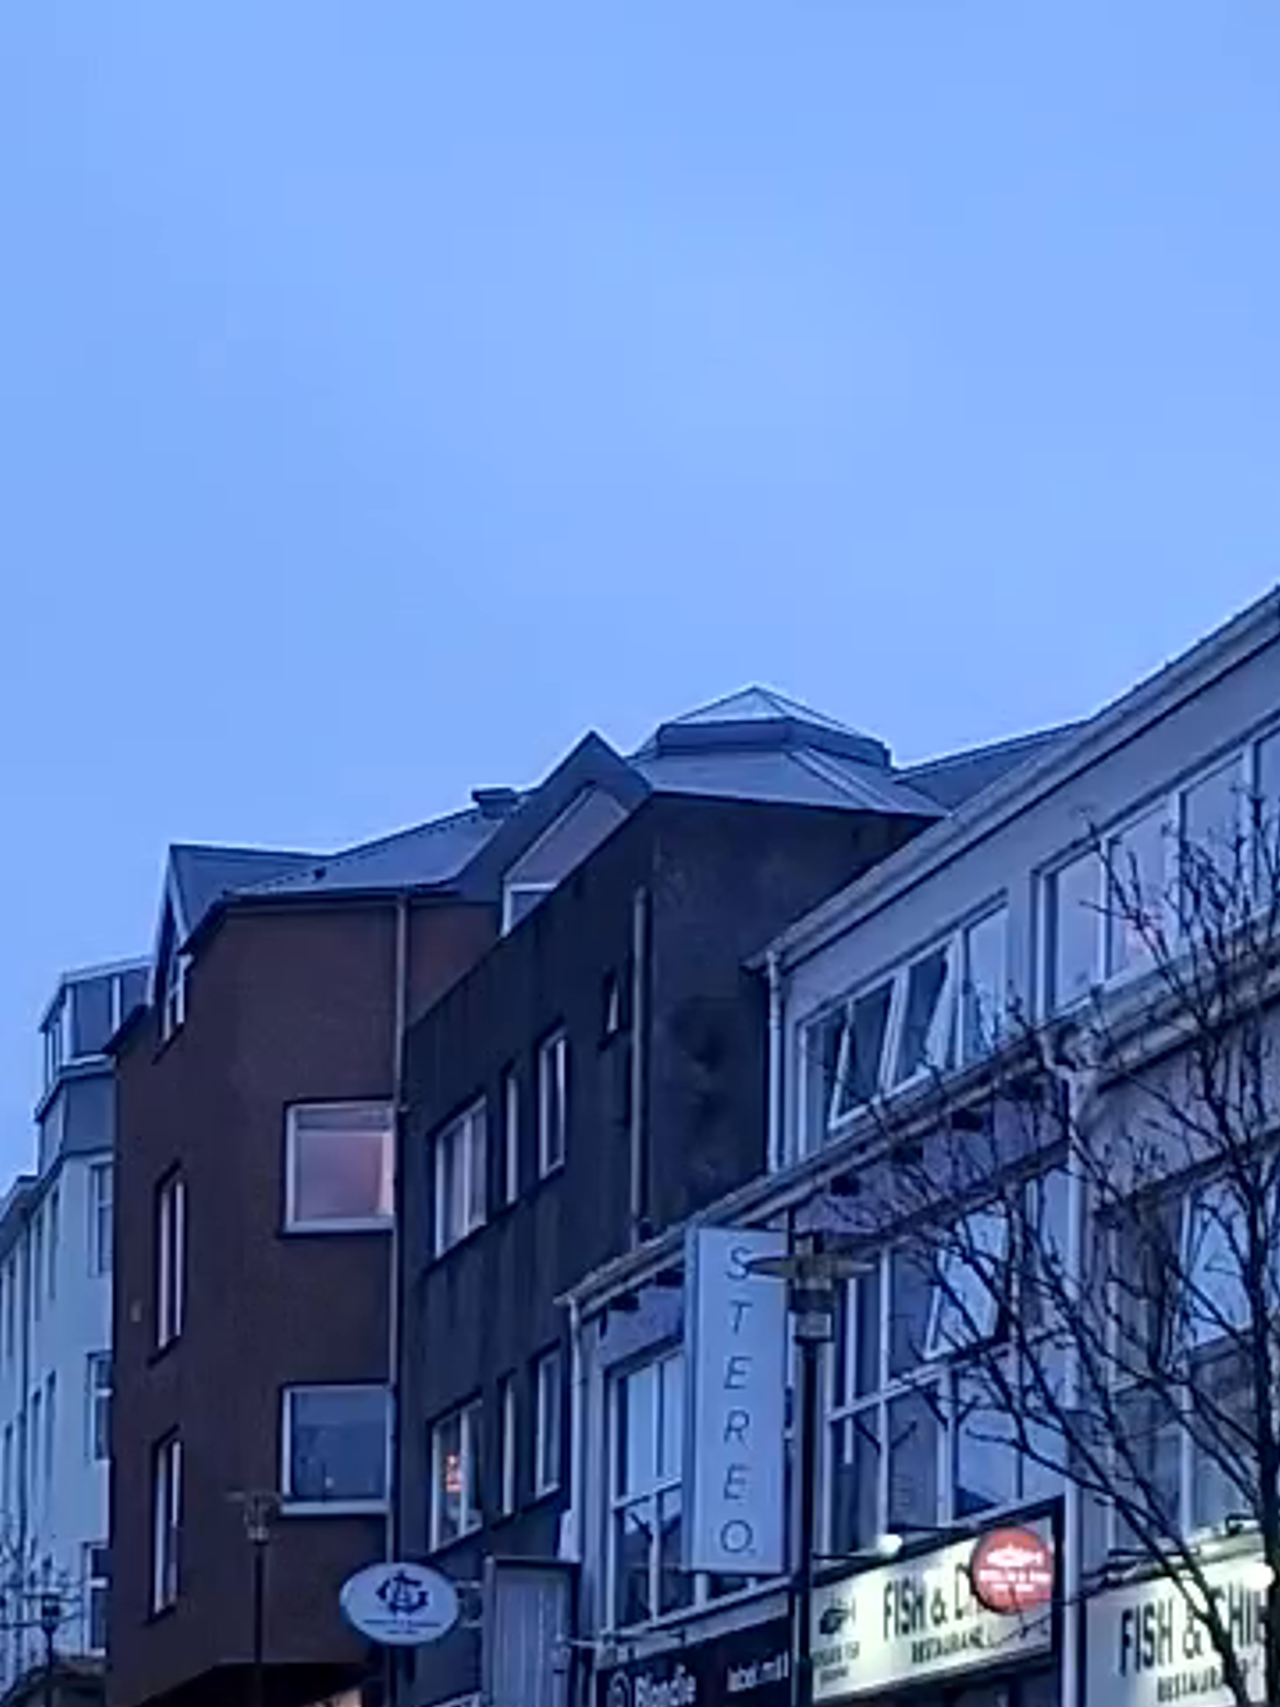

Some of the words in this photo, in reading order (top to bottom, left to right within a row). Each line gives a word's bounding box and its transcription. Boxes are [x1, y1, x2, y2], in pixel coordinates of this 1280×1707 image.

[883, 1577, 927, 1642] FISH
[930, 1588, 948, 1627] &
[1119, 1596, 1174, 1677] FISH
